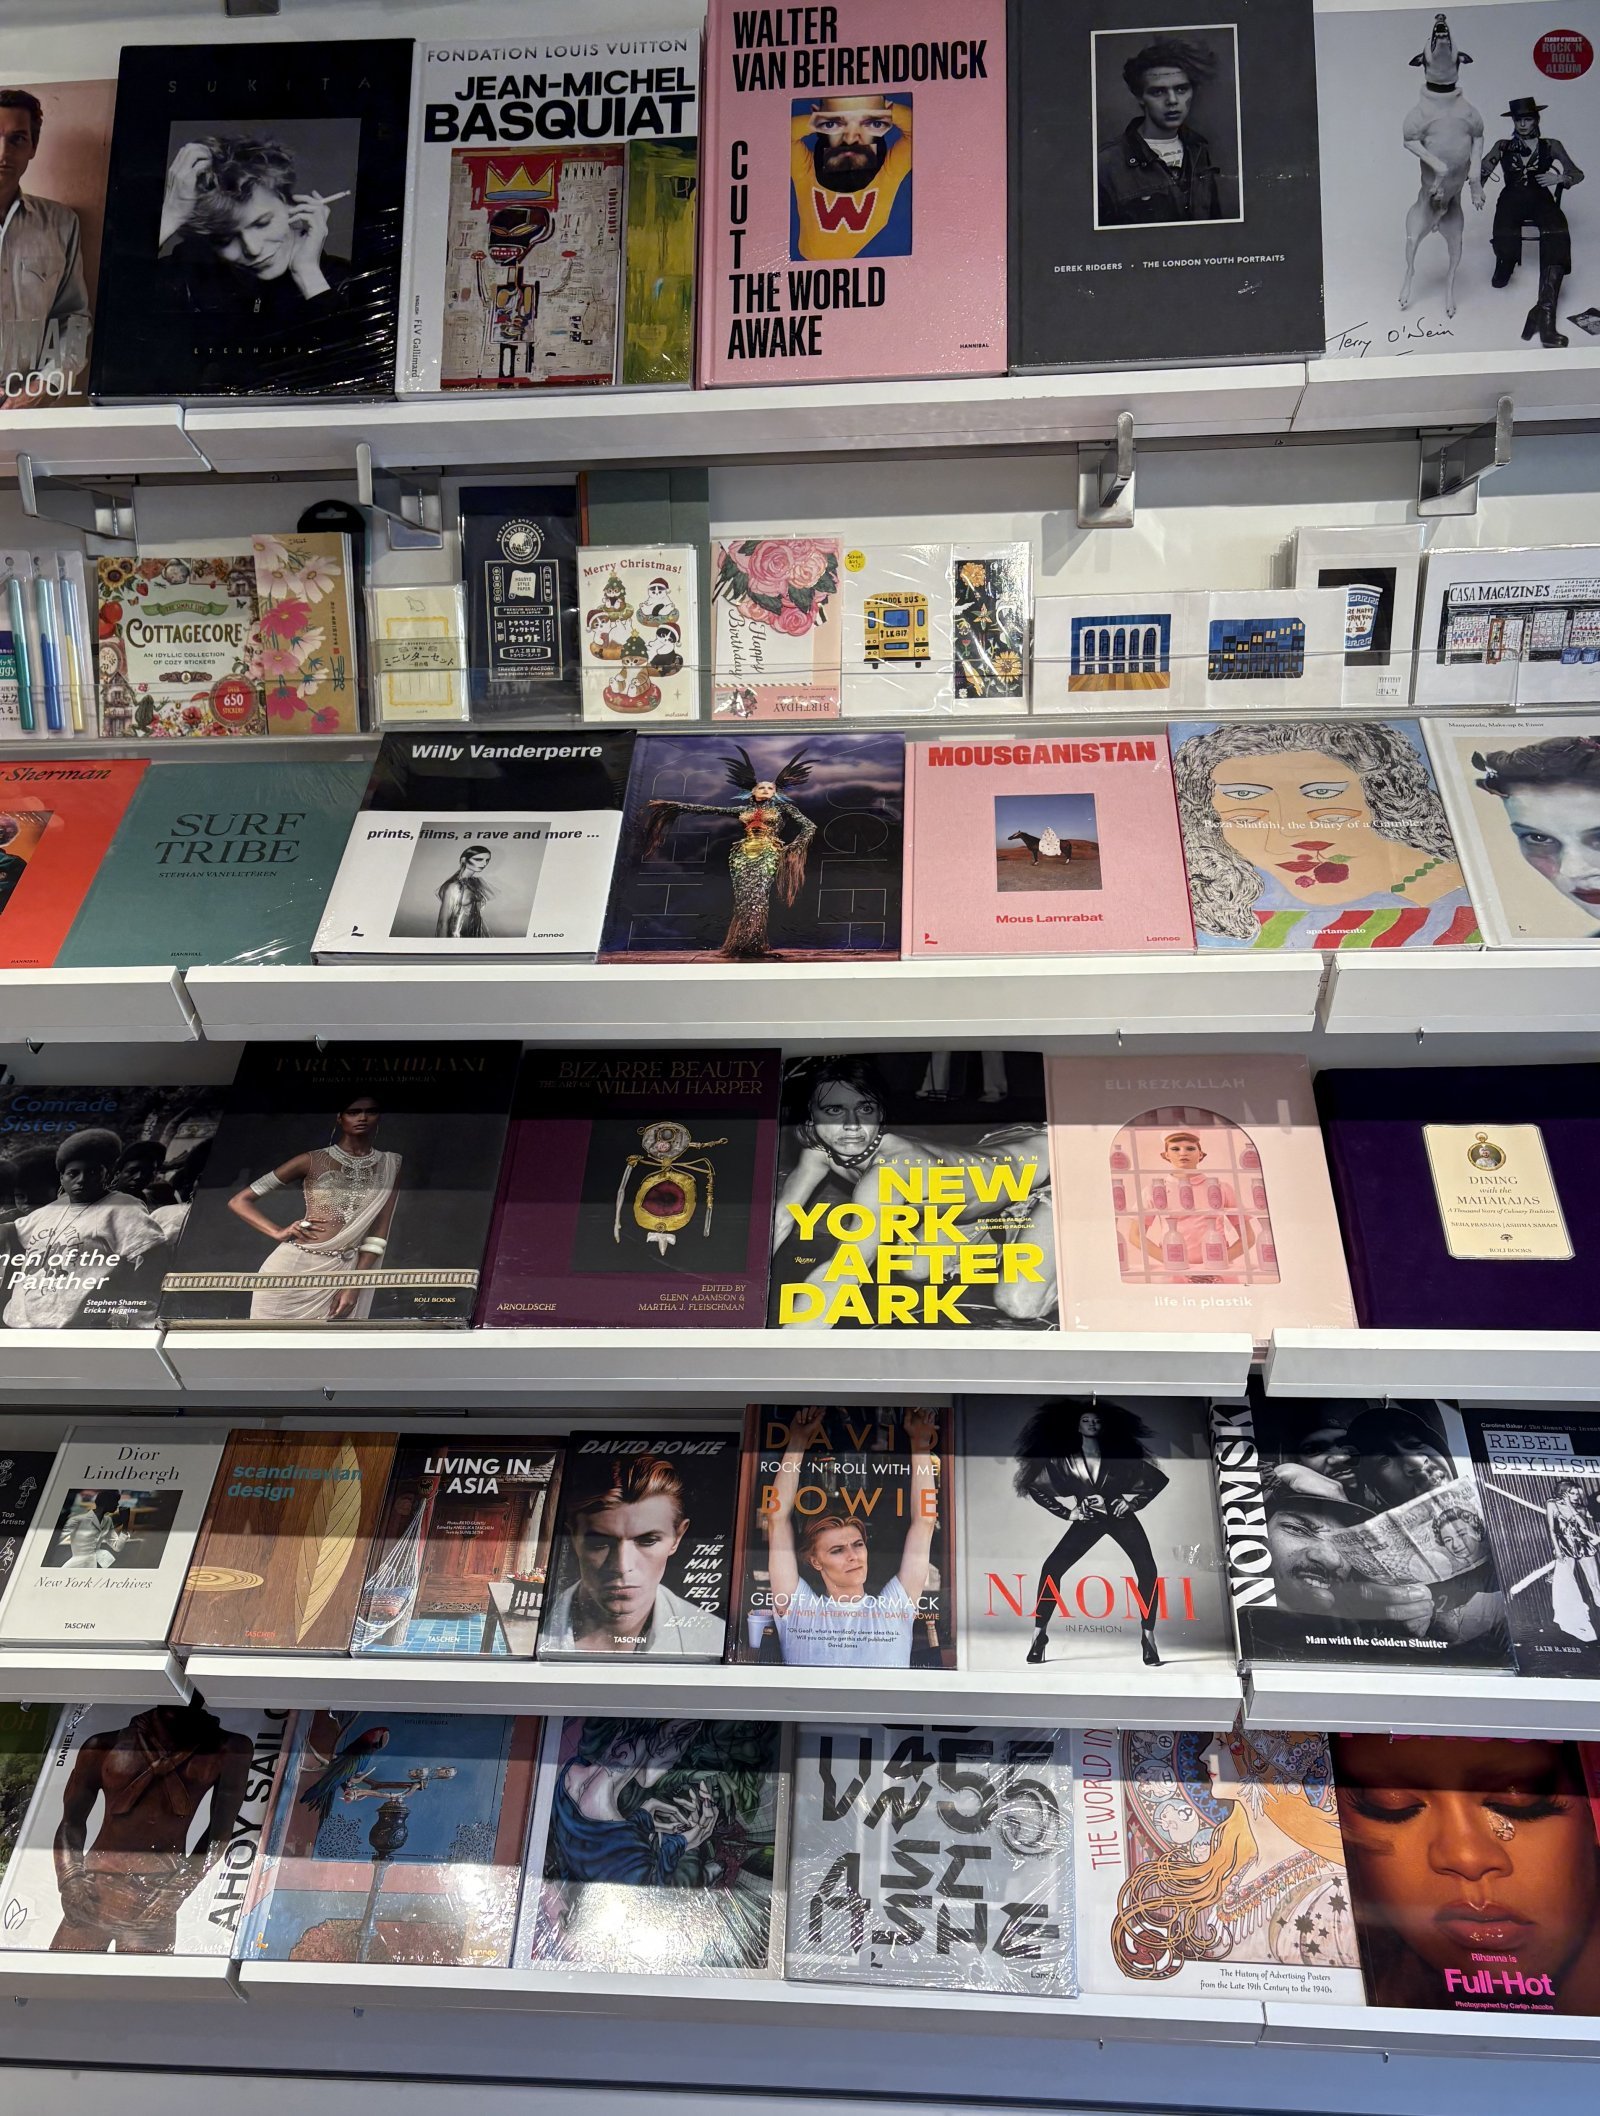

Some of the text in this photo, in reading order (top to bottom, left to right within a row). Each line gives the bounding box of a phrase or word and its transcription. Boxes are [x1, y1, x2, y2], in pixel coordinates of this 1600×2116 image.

[733, 6, 837, 49] WALTER
[427, 39, 687, 62] FONDATION LOUIS VUITTON
[732, 39, 988, 92] VAN BEIRENDONCK
[1546, 64, 1581, 73] ALBUM
[455, 66, 695, 101] JEAN-MICHEL
[424, 94, 695, 142] BASQUIAT
[1054, 262, 1122, 273] DEREK RIDGERS
[1143, 254, 1285, 269] THE LONDON YOUTH PORTRAITS
[729, 267, 885, 314] THE WORLD
[727, 315, 822, 359] AWAKE
[5, 370, 82, 397] COOL
[583, 559, 682, 577] Merry Christmas!
[1450, 585, 1550, 602] CASA MAGAZINES
[728, 609, 748, 680] Birthday
[748, 621, 767, 673] Happy
[224, 693, 244, 706] 650
[773, 703, 830, 713] BIRTHDAY
[411, 744, 602, 761] Willy Vanderperre
[928, 741, 1156, 767] MOUSGANISTAN
[4, 767, 112, 782] Sherman
[170, 812, 306, 838] SURF
[1204, 819, 1233, 828] Reza
[1236, 819, 1285, 830] Shafahi,
[1287, 820, 1306, 829] the
[1309, 821, 1343, 831] Diary
[1349, 819, 1360, 829] of
[1373, 820, 1425, 828] Gambler
[367, 829, 414, 841] prints,
[418, 829, 459, 841] films,
[476, 832, 509, 840] rave
[513, 829, 541, 840] and
[545, 829, 583, 840] more
[155, 840, 301, 866] TRIBE
[996, 913, 1104, 924] Mous Lamrabat
[533, 931, 565, 939] Lannoo
[1306, 927, 1366, 936] apartamento
[558, 1060, 765, 1078] BIZARRE BEAUTY
[1105, 1078, 1246, 1090] ELI REZKALLAH
[10, 1095, 118, 1113] Comrade
[0, 1116, 78, 1133] Sisters
[879, 1155, 1040, 1165] DUSTIN PITTMAN
[878, 1164, 1038, 1204] NEW
[1469, 1176, 1518, 1185] DINING
[1457, 1196, 1541, 1205] MAHARAJAS
[785, 1203, 970, 1243] YORK
[47, 1248, 79, 1267] of
[80, 1248, 120, 1267] the
[823, 1243, 1046, 1285] AFTER
[7, 1271, 110, 1290] Panther
[702, 1284, 746, 1292] EDITED BY
[107, 1307, 138, 1315] Huggins
[496, 1303, 557, 1311] ARNOLDSCHE
[638, 1303, 745, 1311] MARTHA J. FLEISCHMAN
[778, 1283, 972, 1325] DARK
[1154, 1295, 1253, 1310] life in plastik
[766, 1422, 939, 1452] DAVID
[1487, 1433, 1567, 1451] REBEL
[117, 1446, 161, 1461] Dior
[578, 1440, 727, 1456] DAVID BOWIE
[232, 1465, 363, 1481] scandinavian
[423, 1457, 532, 1475] LIVING IN
[760, 1461, 801, 1473] ROCK
[833, 1462, 868, 1475] ROLL
[872, 1463, 910, 1476] WITH
[916, 1464, 939, 1476] ME
[1493, 1455, 1600, 1474] STYLIST
[82, 1466, 181, 1484] Lindbergh
[227, 1482, 296, 1501] design
[446, 1477, 500, 1495] ASIA
[760, 1485, 939, 1519] BOWIE
[1, 1518, 26, 1526] Artists
[694, 1544, 724, 1556] THE
[684, 1558, 723, 1570] MAN
[682, 1572, 722, 1584] WHO
[684, 1587, 719, 1599] FELL
[750, 1592, 939, 1611] GEOFF MACCORMACK
[984, 1572, 1200, 1621] NAOMI
[696, 1601, 721, 1613] TO
[1065, 1624, 1122, 1633] IN FASHION
[428, 1635, 460, 1643] TASCHEN
[614, 1636, 647, 1644] TASCHEN
[1305, 1635, 1448, 1649] Man with the Golden Shutter
[56, 1731, 75, 1767] DANIEL
[1082, 1753, 1117, 1823] WORLD
[1088, 1832, 1121, 1870] THE
[1471, 1952, 1517, 1963] Rihanna is
[1219, 1968, 1331, 1983] The History of Advertising Posters
[1444, 1968, 1556, 1996] Full-Hot
[1200, 1979, 1216, 1990] from
[1230, 1982, 1245, 1990] Late
[1247, 1982, 1262, 1990] 19th
[1263, 1982, 1290, 1994] Century
[1291, 1984, 1299, 1992] to
[1300, 1984, 1311, 1992] the
[1313, 1985, 1333, 1993] 1940s
